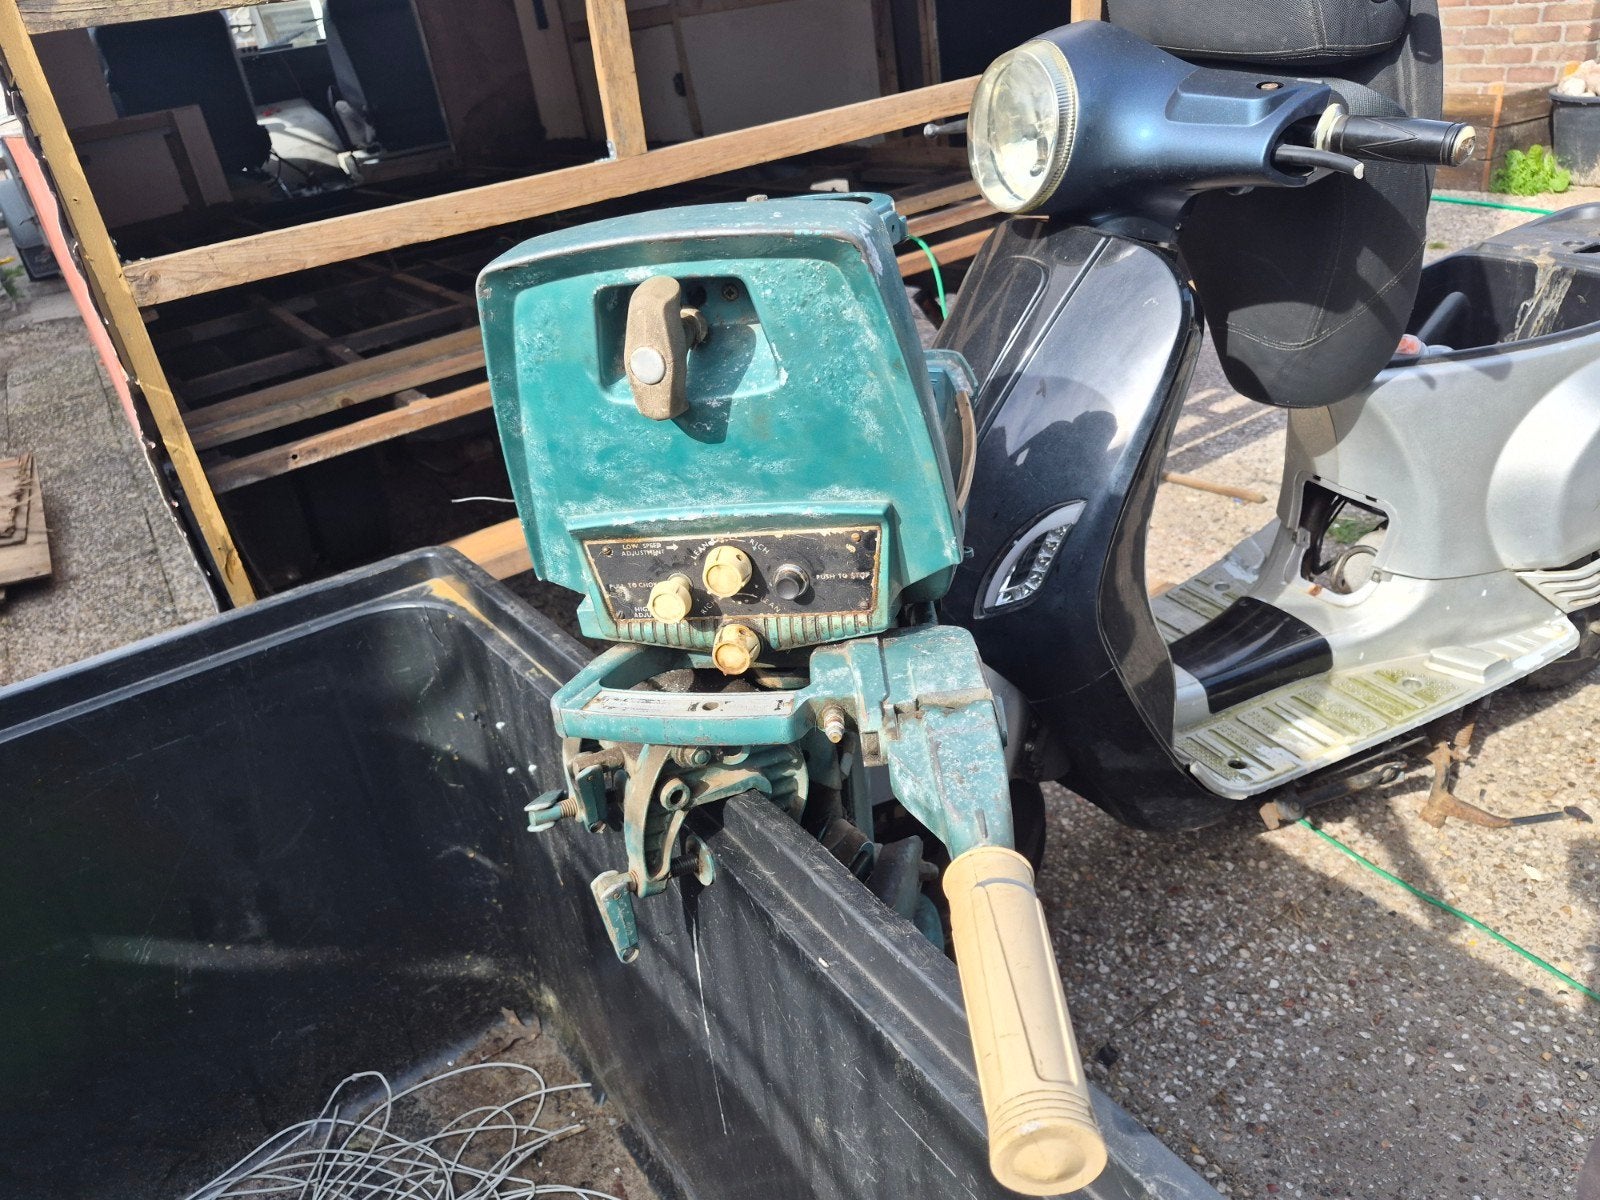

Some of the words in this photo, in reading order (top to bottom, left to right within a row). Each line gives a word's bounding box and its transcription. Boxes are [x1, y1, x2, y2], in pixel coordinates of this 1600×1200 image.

[621, 549, 665, 557] ADJUSTMENT
[691, 540, 710, 560] LEAN
[749, 538, 770, 555] RICH
[850, 571, 870, 580] STOP
